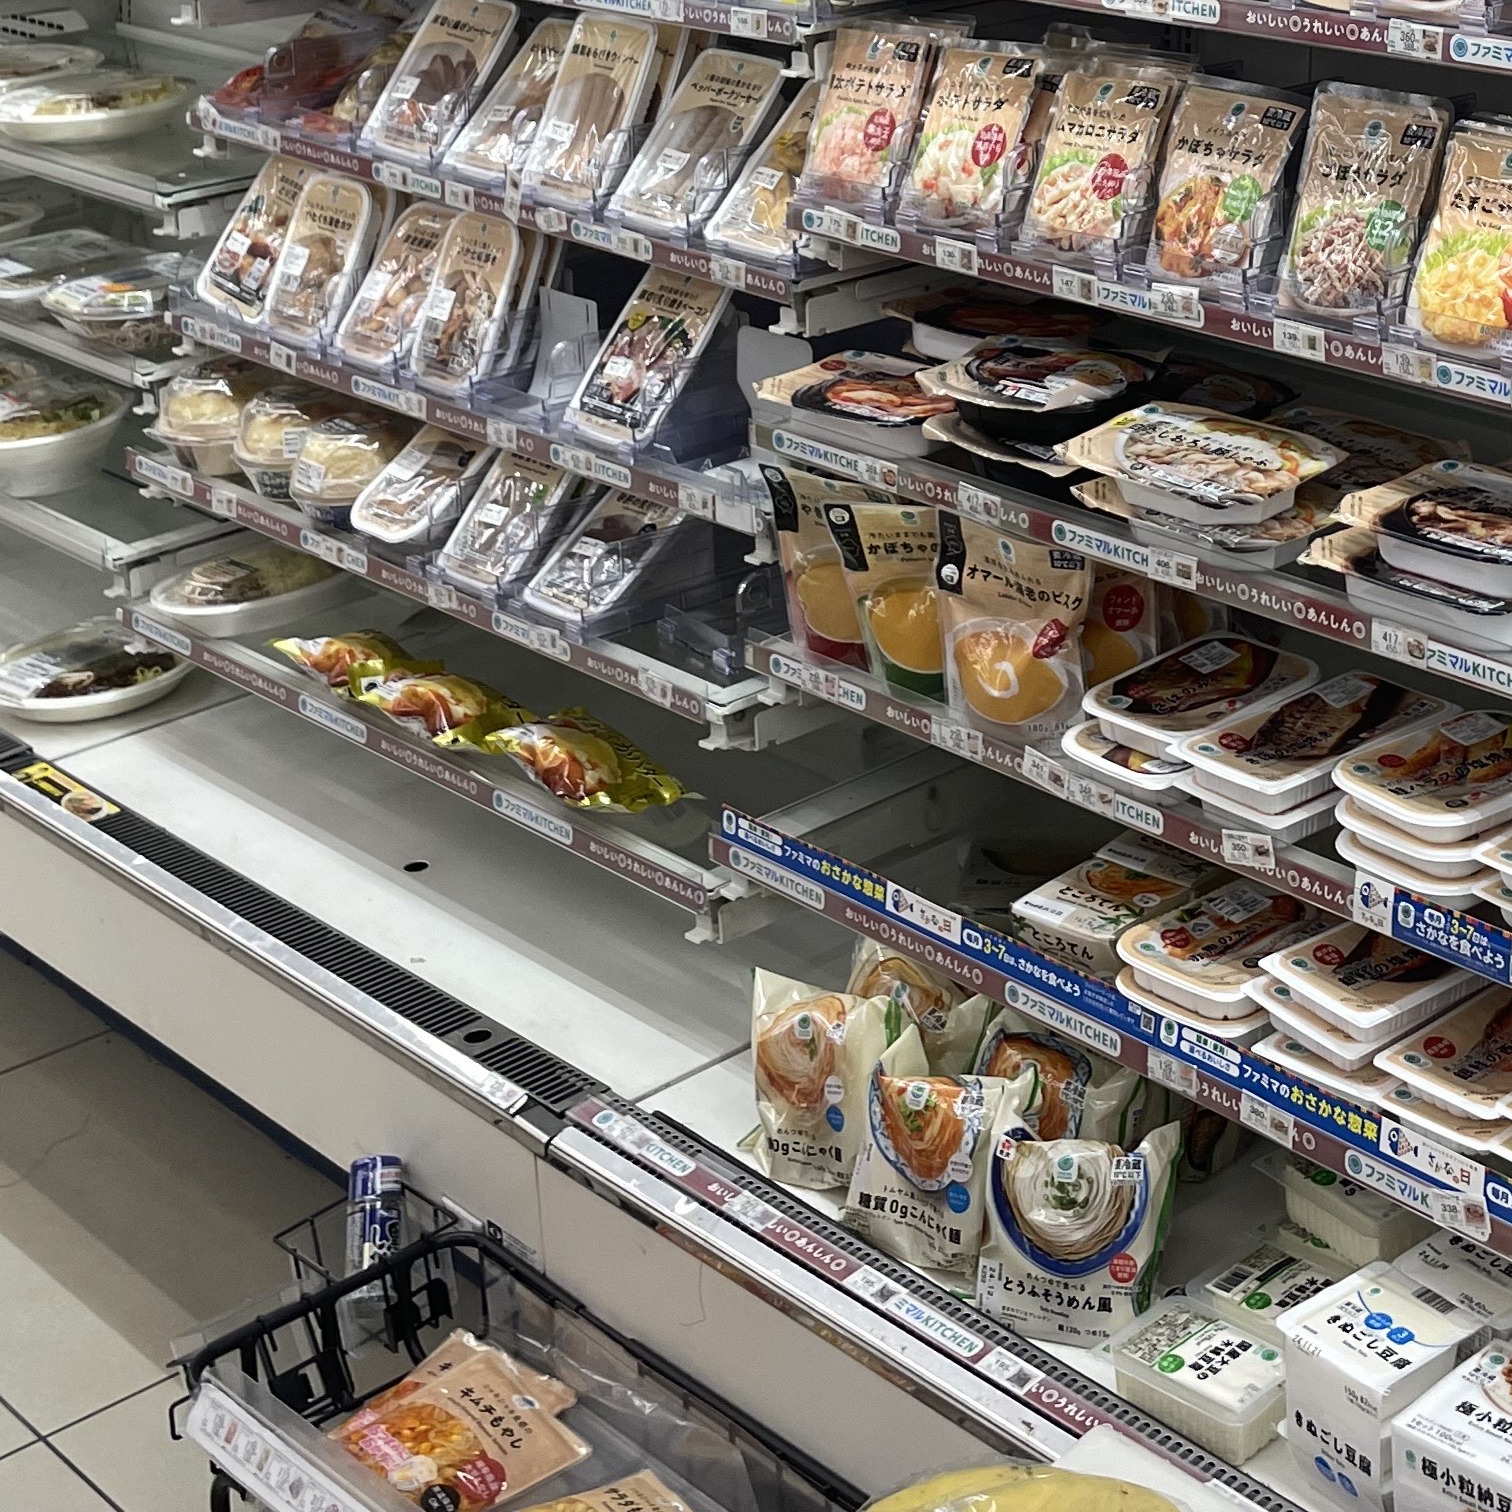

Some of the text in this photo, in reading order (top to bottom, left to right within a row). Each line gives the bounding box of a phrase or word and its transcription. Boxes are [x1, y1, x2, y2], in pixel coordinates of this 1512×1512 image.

[741, 855, 824, 905] ファミマルKITCHEN
[1020, 987, 1118, 1050] ファミマルKITCHEN
[1003, 1276, 1113, 1312] とうふそうめん風
[1326, 1314, 1412, 1370] きぬごし豆腐
[1294, 1410, 1372, 1477] きぬごし豆腐
[1421, 1456, 1512, 1511] 極小粒納豆
